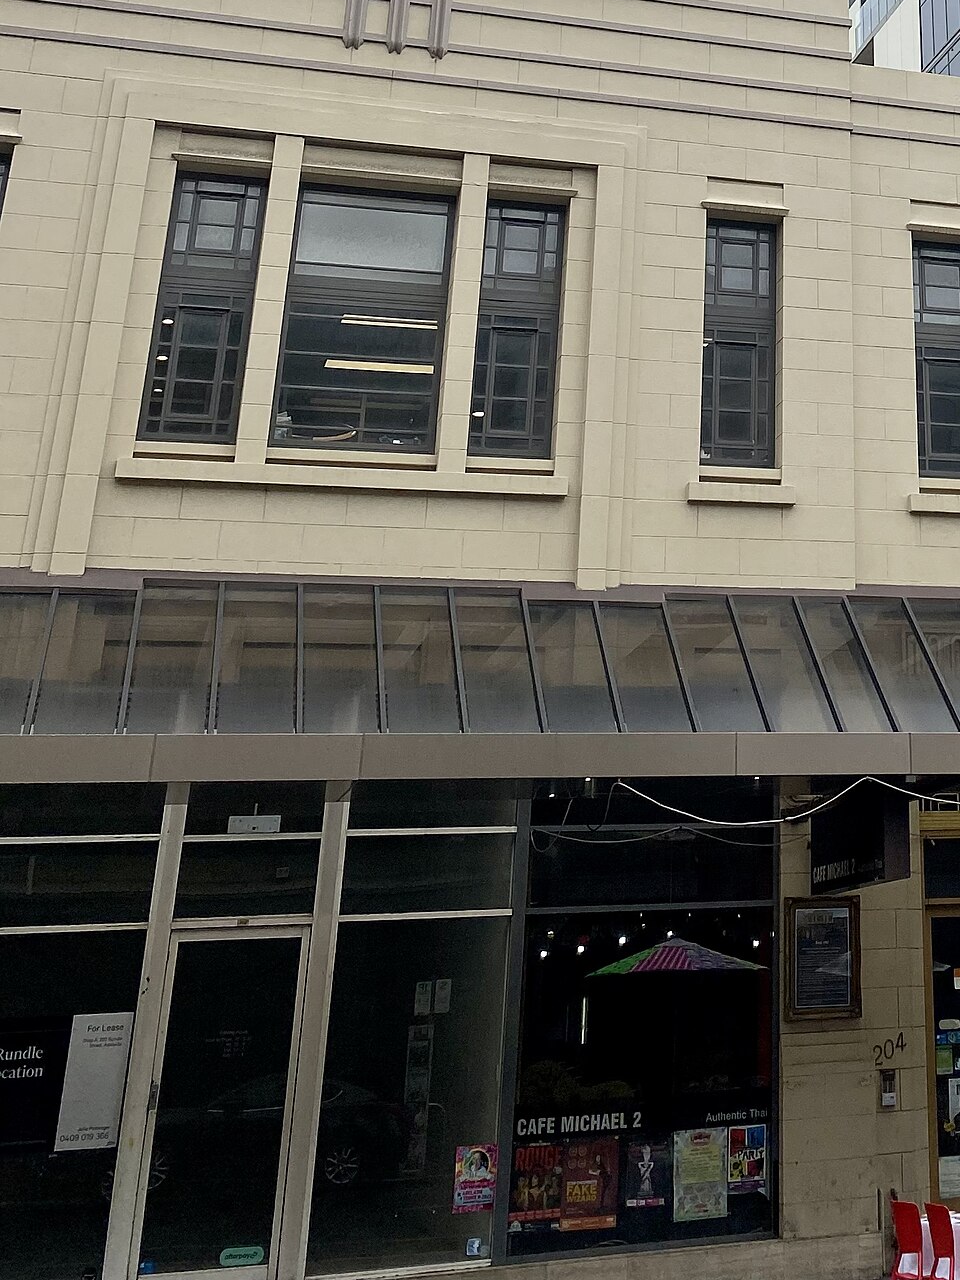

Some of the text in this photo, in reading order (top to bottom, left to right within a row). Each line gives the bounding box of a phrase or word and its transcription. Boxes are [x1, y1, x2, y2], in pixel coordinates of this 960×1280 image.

[812, 865, 826, 884] CAFE
[851, 858, 856, 874] 2
[87, 1024, 124, 1032] For Lease
[873, 1031, 907, 1066] 204
[0, 1065, 43, 1079] cation
[705, 1108, 768, 1122] Authentic Thai
[517, 1111, 642, 1136] CAFE MICHAEL 2
[59, 1133, 79, 1142] 0409
[736, 1147, 765, 1160] PARTY
[566, 1184, 597, 1196] FAKE
[566, 1195, 597, 1203] WIZARD
